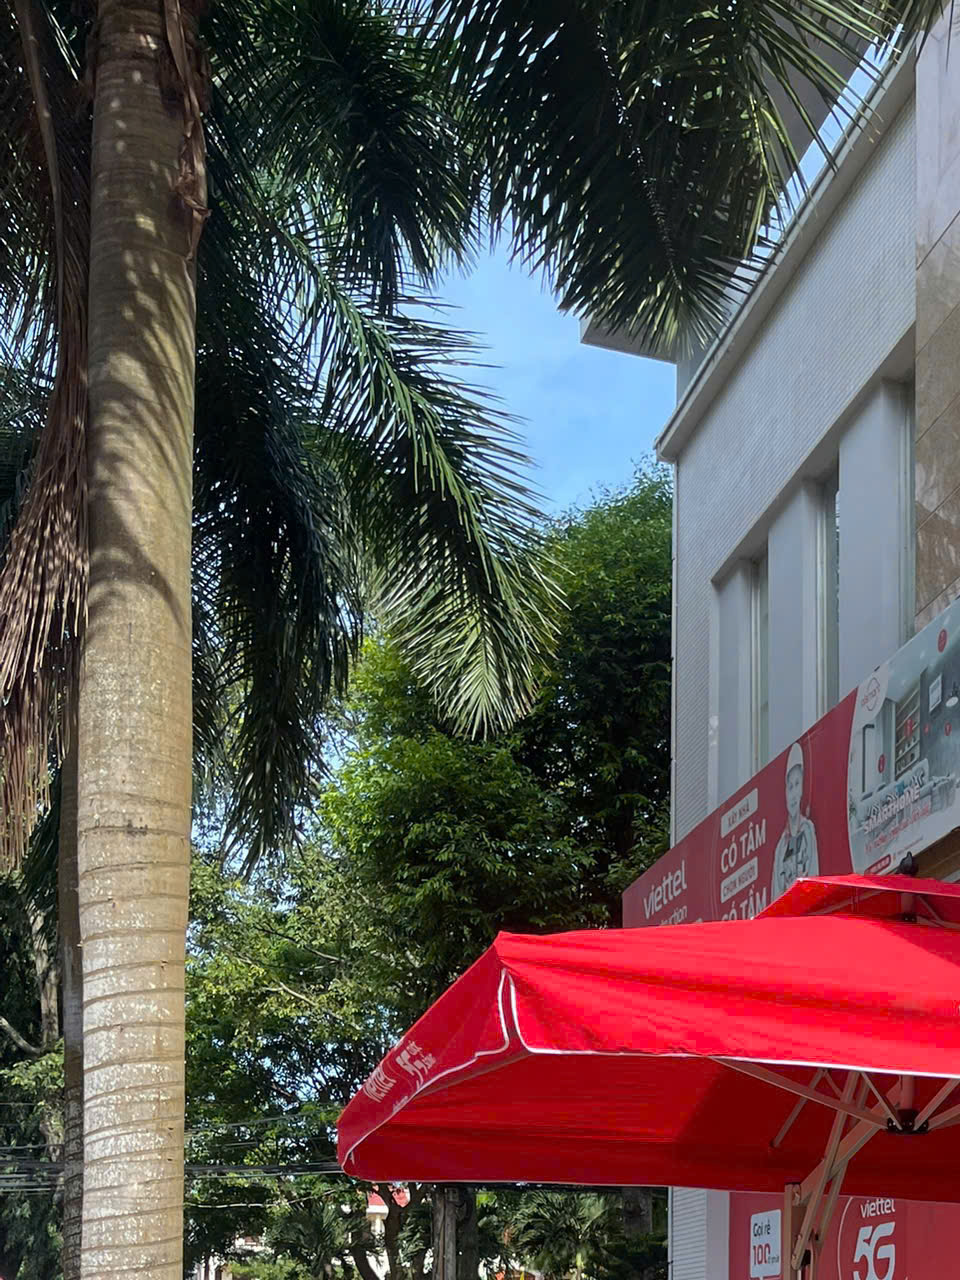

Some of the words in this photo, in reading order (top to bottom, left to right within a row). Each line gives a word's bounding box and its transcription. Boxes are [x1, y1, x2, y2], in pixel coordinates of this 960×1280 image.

[720, 834, 738, 874] CÓ
[739, 817, 766, 859] TÂM
[643, 859, 688, 920] viettel
[860, 1198, 897, 1218] viettel
